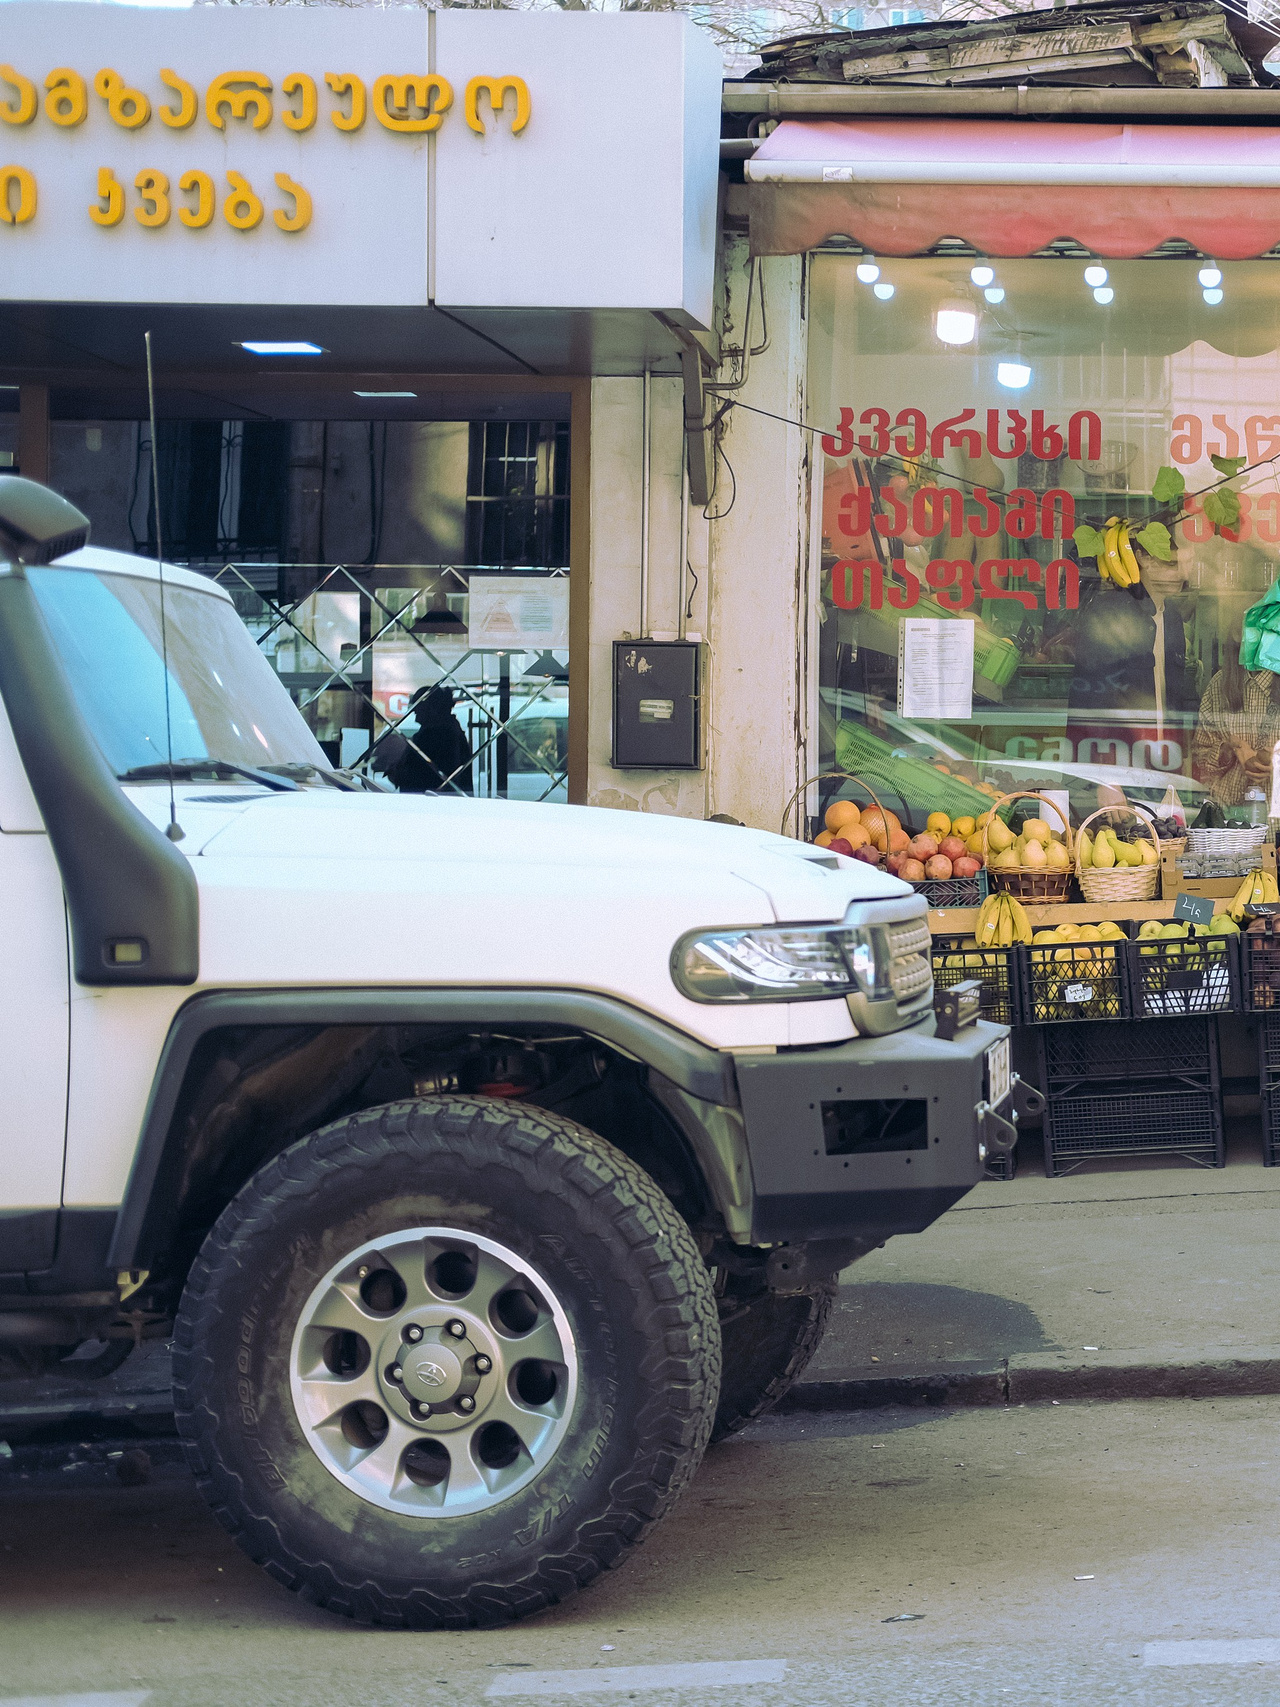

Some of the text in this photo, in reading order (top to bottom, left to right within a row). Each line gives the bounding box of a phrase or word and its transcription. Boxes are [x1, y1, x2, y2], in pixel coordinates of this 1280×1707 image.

[0, 64, 531, 134] ამზარეულო
[88, 167, 313, 233] კვება
[821, 406, 1102, 461] კვერცხი
[837, 486, 1076, 540] ქათამი
[831, 558, 1080, 610] თაფლი
